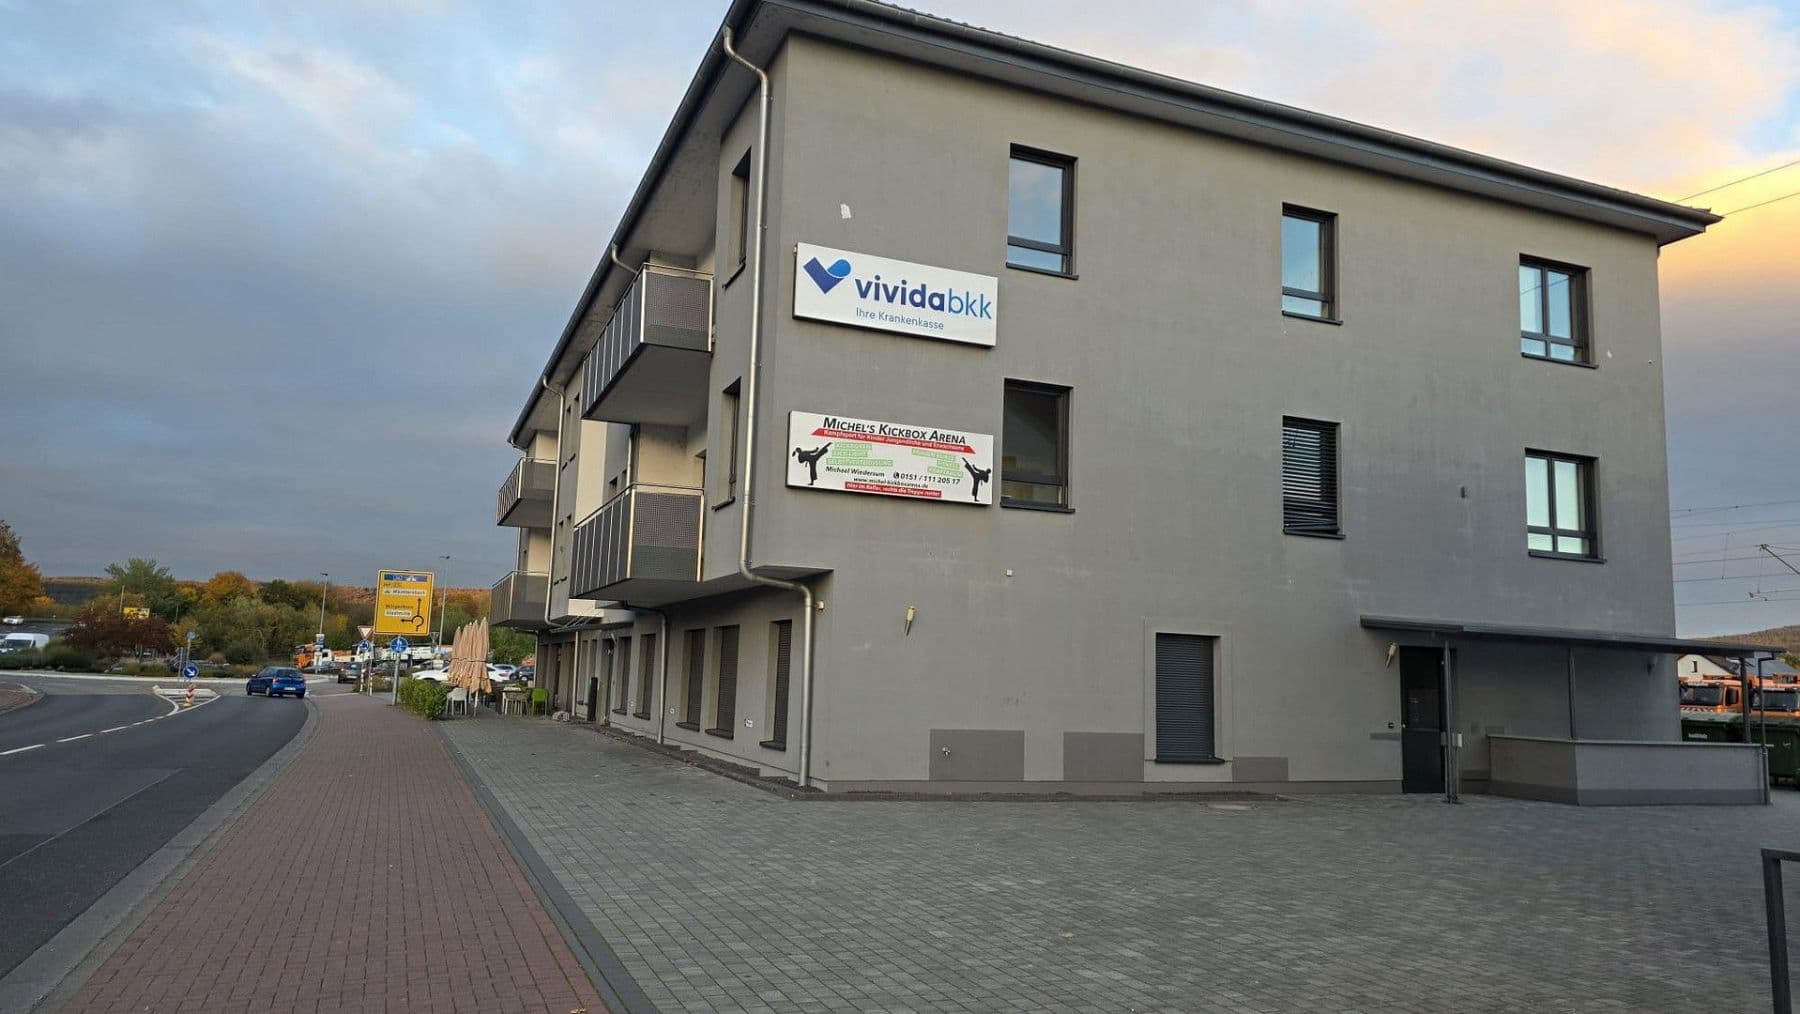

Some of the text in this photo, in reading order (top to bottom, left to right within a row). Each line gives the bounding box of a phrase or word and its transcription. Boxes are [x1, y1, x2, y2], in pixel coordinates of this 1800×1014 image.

[855, 275, 991, 319] vividabkk
[856, 307, 944, 330] Ihre Krankenkasse
[929, 430, 966, 444] ARENA
[826, 466, 850, 474] Michael
[901, 472, 917, 480] 0151
